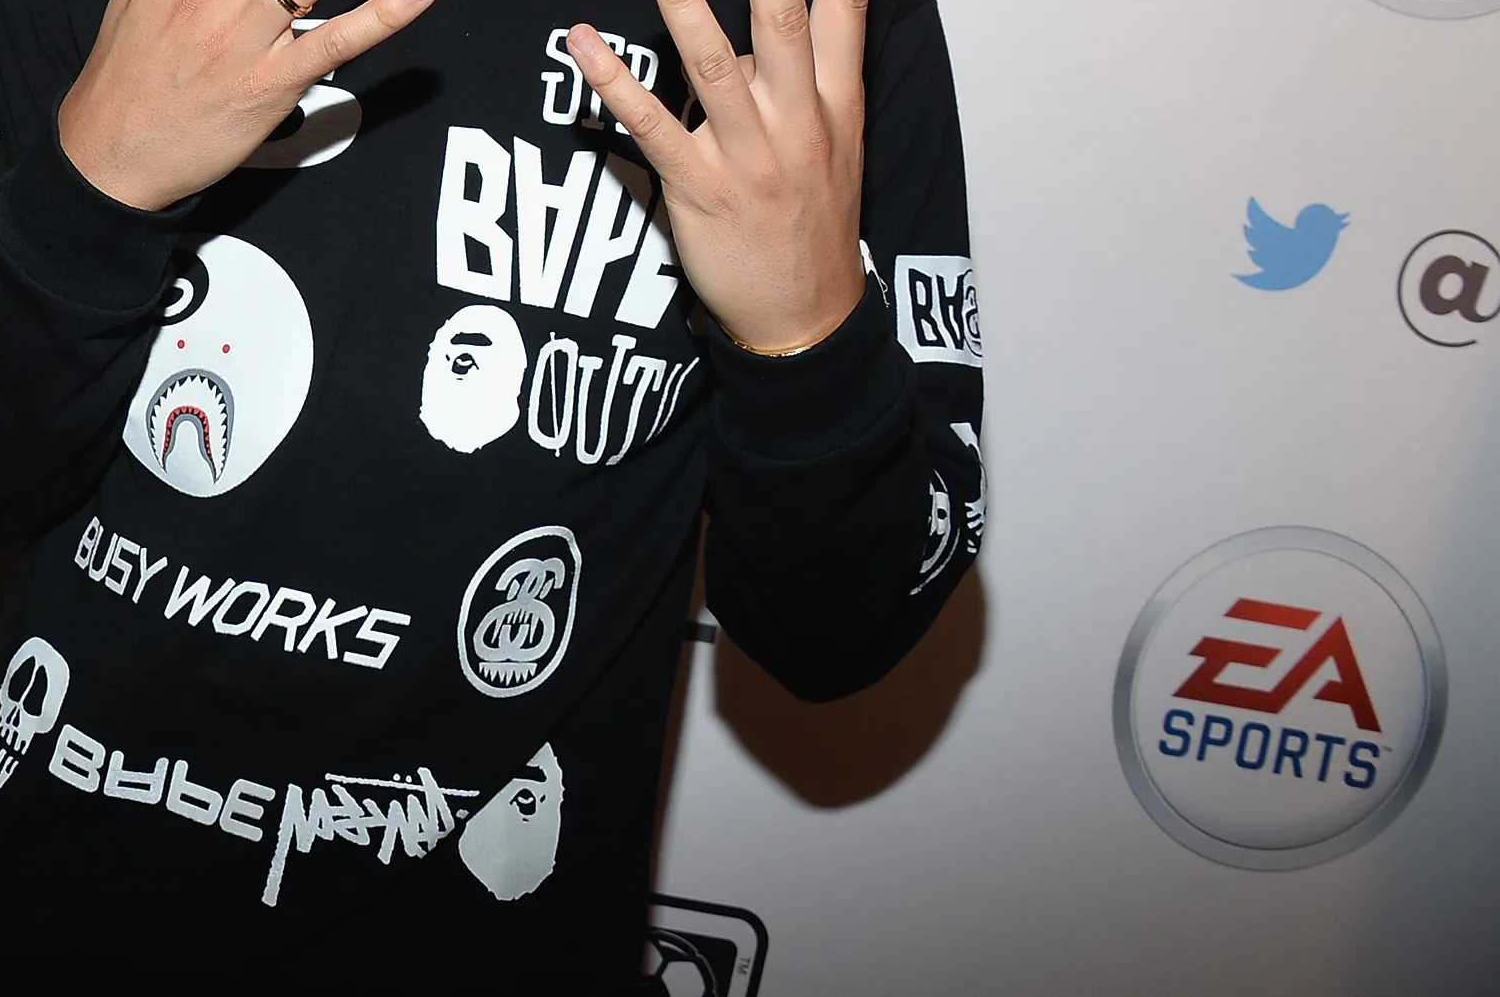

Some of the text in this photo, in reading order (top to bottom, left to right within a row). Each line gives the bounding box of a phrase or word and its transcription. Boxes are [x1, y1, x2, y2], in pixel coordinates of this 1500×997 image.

[74, 516, 412, 670] BUSY WORKS
[1172, 597, 1382, 733] EA
[1158, 707, 1380, 790] SPORTS
